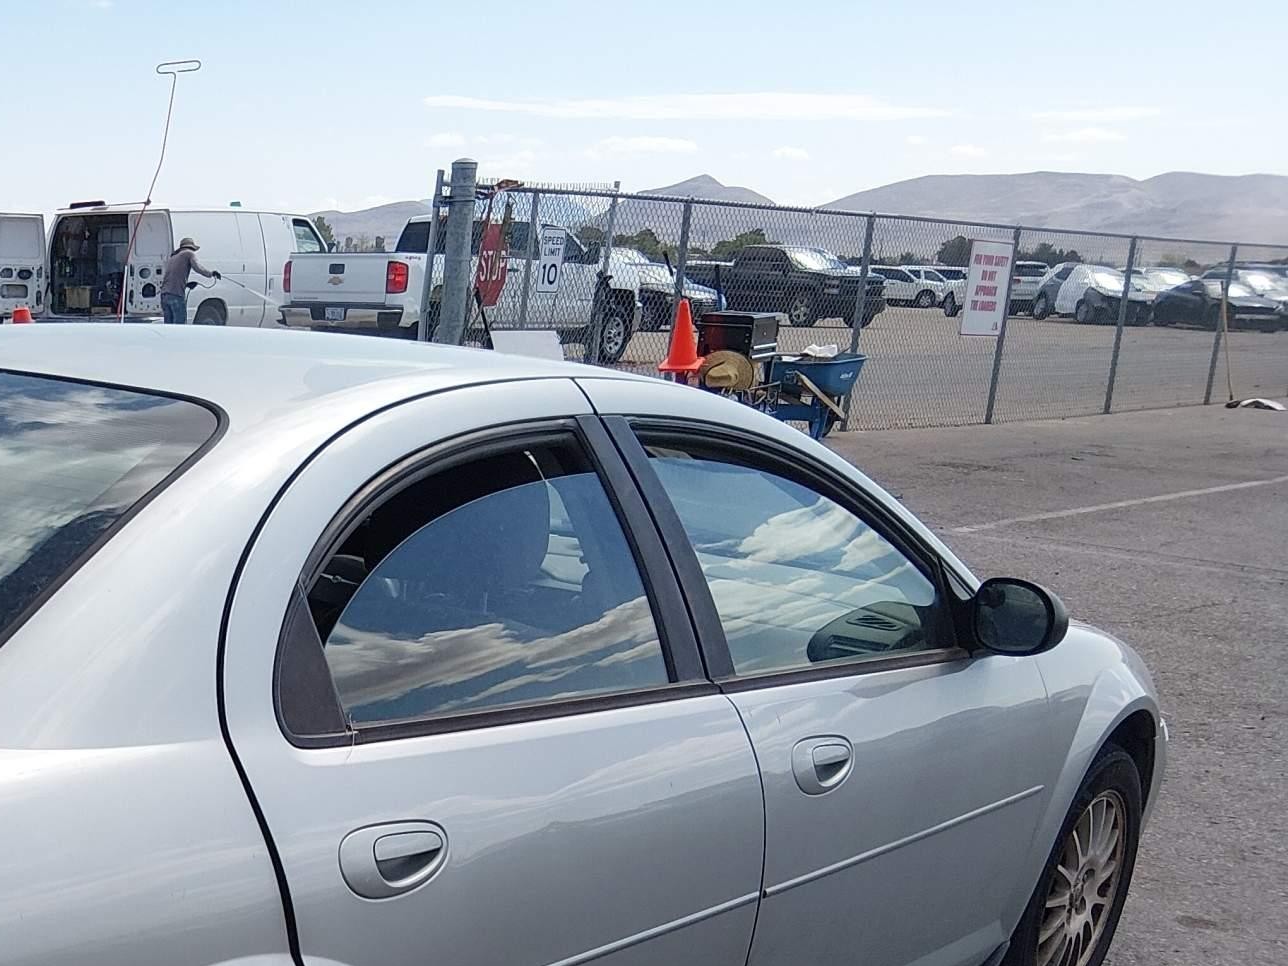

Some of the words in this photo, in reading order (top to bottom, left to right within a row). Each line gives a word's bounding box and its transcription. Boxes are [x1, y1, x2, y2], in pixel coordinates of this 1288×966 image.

[543, 235, 564, 246] SPEED
[543, 247, 562, 257] LIMIT
[479, 250, 508, 282] STOP
[541, 263, 558, 285] 10
